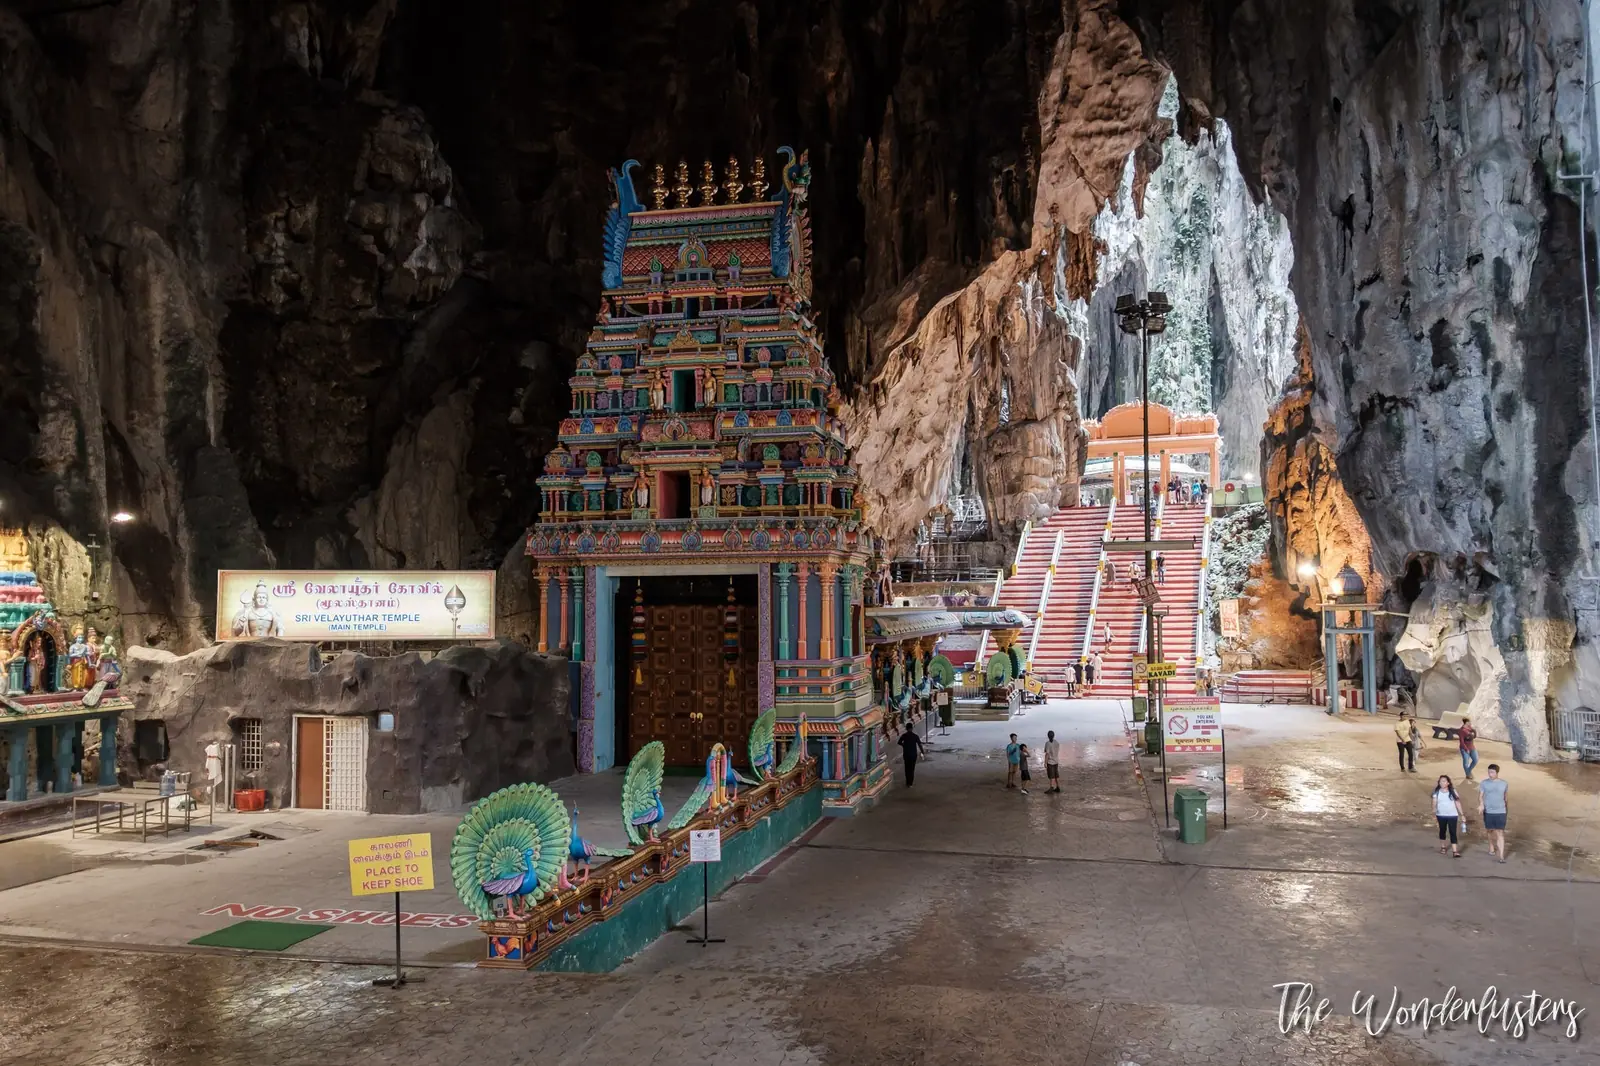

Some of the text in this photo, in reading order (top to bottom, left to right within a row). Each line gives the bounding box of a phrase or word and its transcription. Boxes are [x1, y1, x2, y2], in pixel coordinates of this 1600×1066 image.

[272, 580, 444, 597] ஸ்ரீ வேலாயுதர் கோவில்
[295, 613, 420, 622] SRI VELAYUTHAR TEMPLE
[328, 623, 387, 631] (MAIN TEMPLE)
[1148, 670, 1176, 678] KAVADI
[365, 863, 419, 877] PLACE TO
[362, 876, 424, 890] KEEP SHOE
[199, 903, 481, 929] NO SHOES
